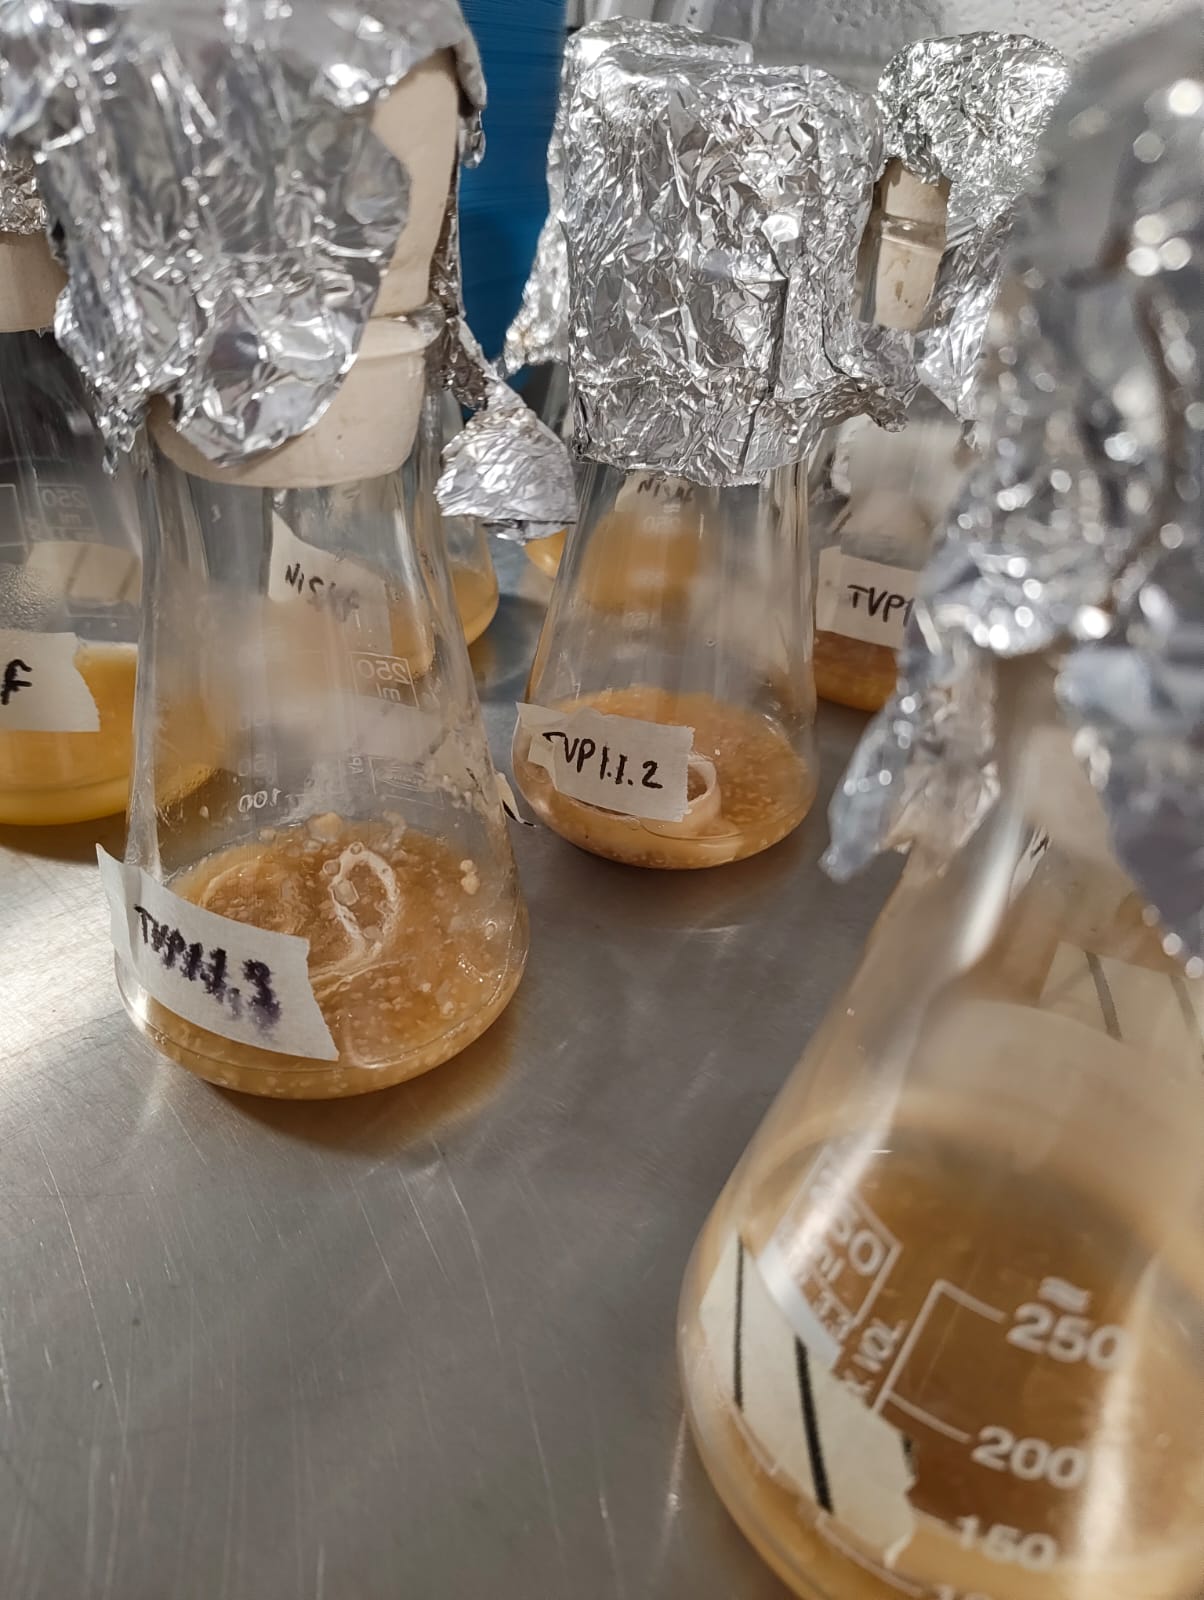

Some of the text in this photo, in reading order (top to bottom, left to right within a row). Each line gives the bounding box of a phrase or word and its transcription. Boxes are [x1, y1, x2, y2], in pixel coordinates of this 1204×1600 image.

[542, 731, 663, 790] TVP1.1.2
[1005, 1301, 1129, 1371] 250
[971, 1424, 1086, 1489] 200
[956, 1515, 1057, 1572] 150
